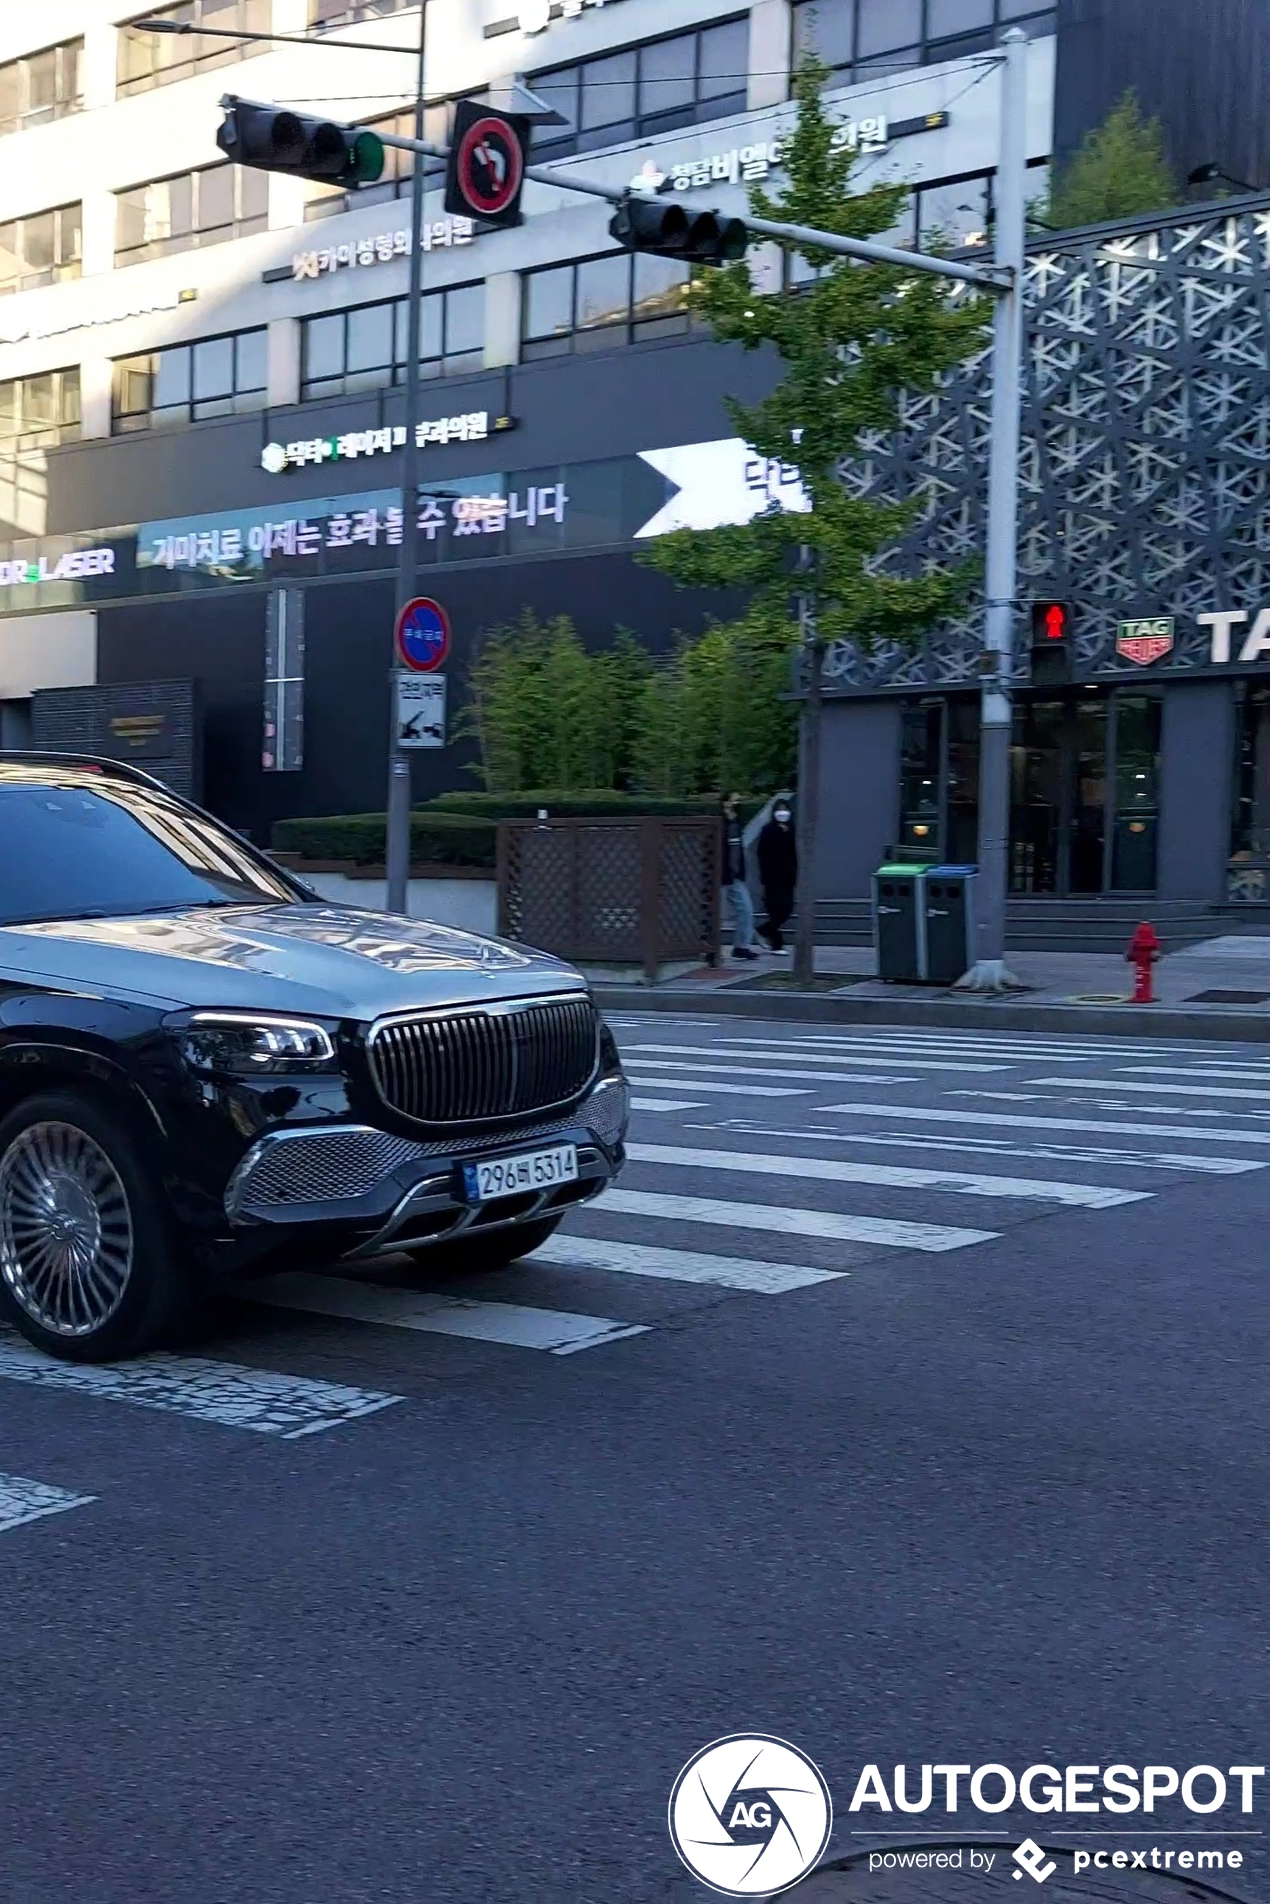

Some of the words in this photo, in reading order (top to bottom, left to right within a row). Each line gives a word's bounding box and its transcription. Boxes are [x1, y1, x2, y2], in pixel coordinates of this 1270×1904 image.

[152, 528, 244, 570] 기미치료
[248, 519, 323, 558] 이제는
[416, 501, 446, 540] 수
[452, 483, 569, 537] 있습니다
[1121, 620, 1170, 637] TAG
[534, 1149, 574, 1184] 5314
